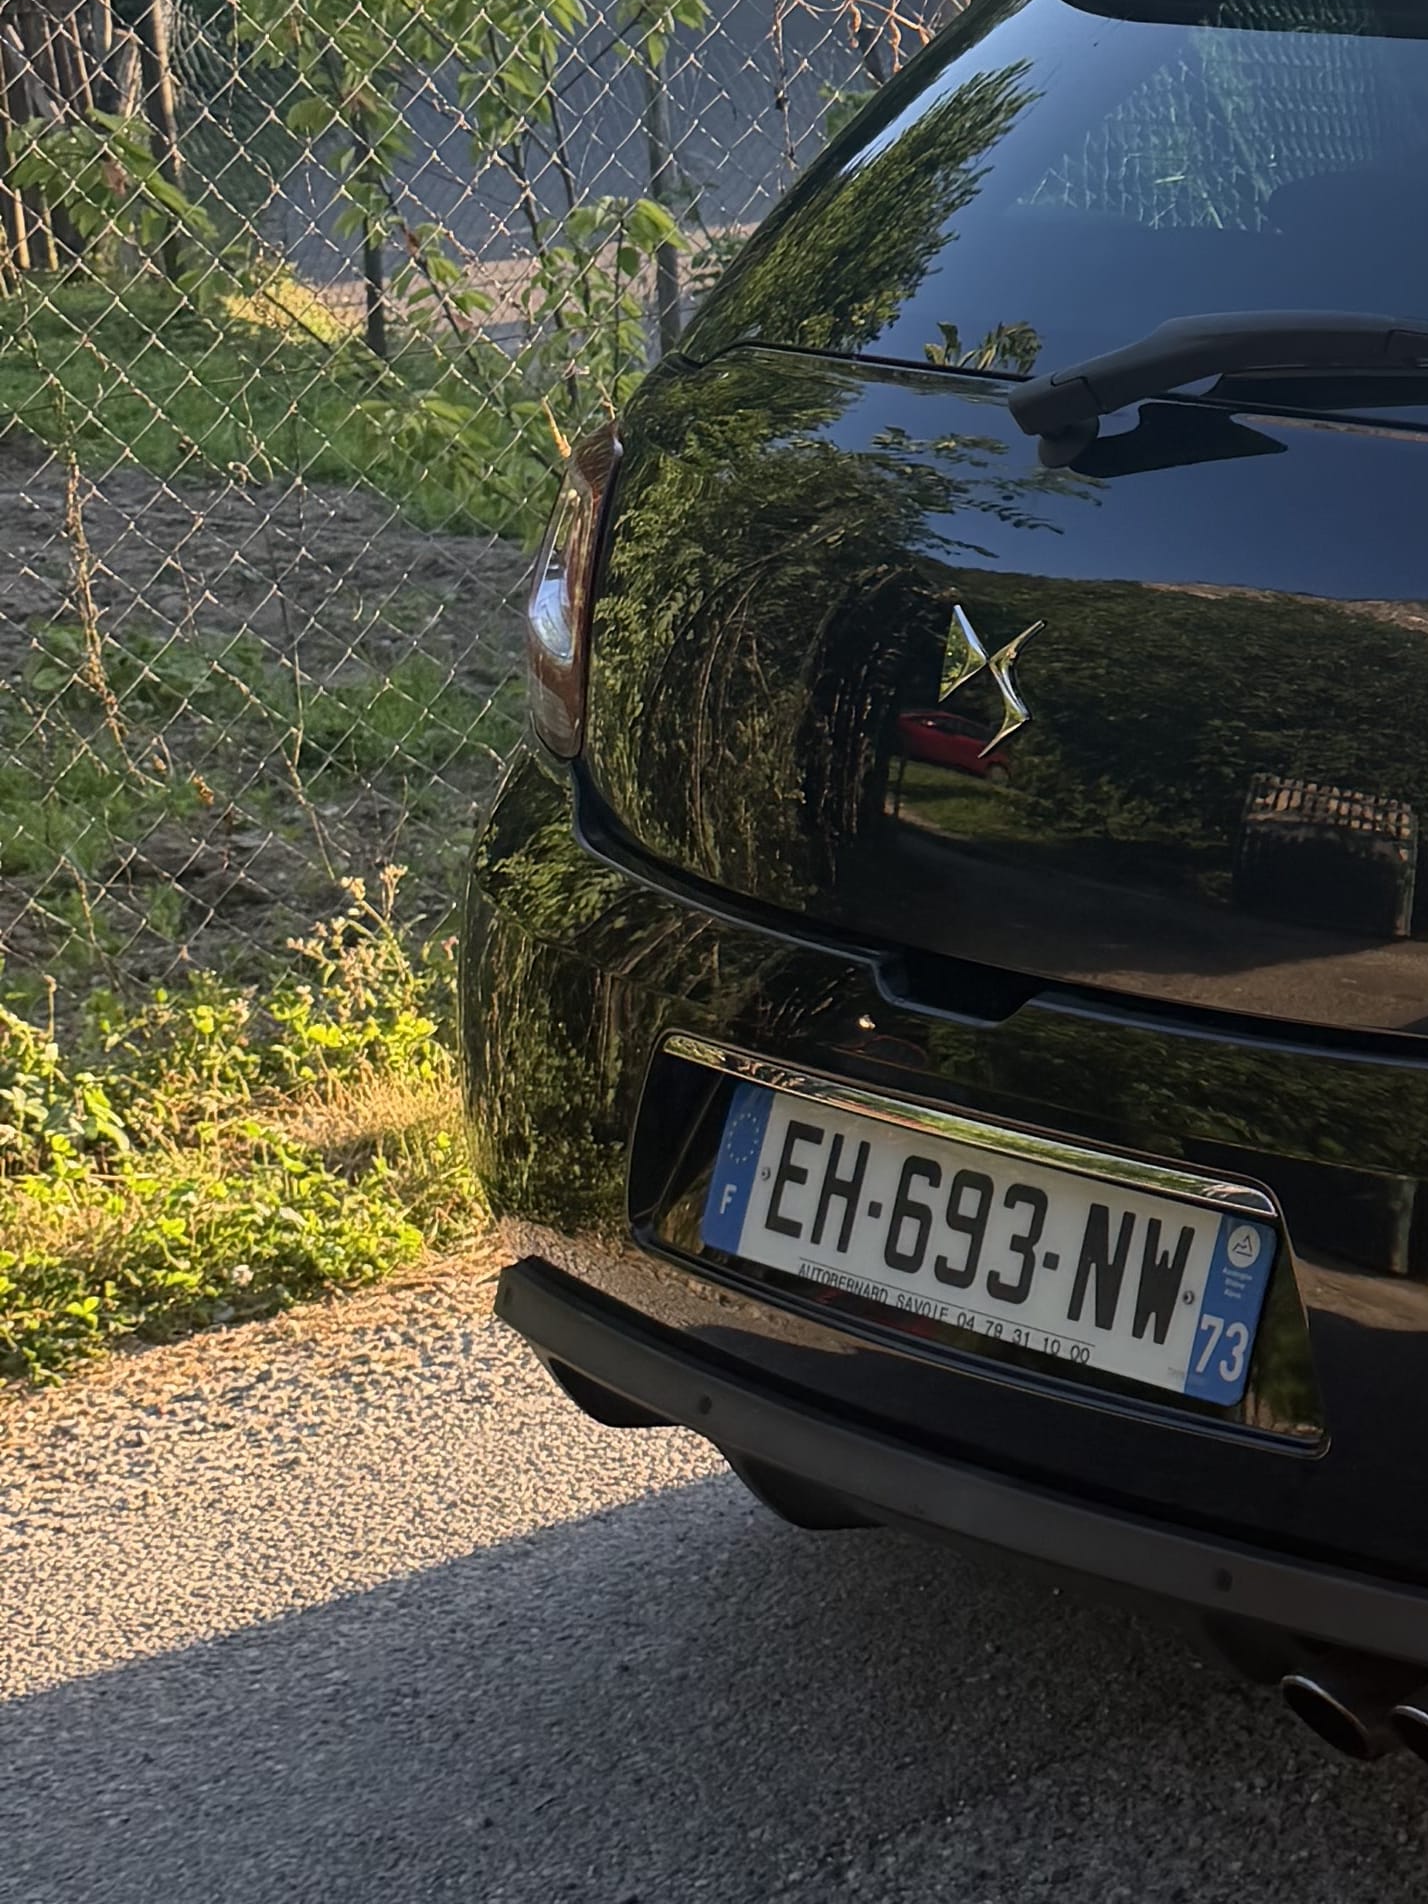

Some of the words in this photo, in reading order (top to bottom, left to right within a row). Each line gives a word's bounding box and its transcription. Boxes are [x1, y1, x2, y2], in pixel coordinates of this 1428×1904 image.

[720, 1183, 738, 1215] F
[765, 1119, 1196, 1346] EH-693-NW
[896, 1293, 949, 1320] SAVOIE
[957, 1311, 976, 1331] 04
[1012, 1328, 1031, 1347] 31
[1044, 1336, 1061, 1357] 10
[1070, 1344, 1091, 1366] 00
[1195, 1313, 1249, 1383] 73
